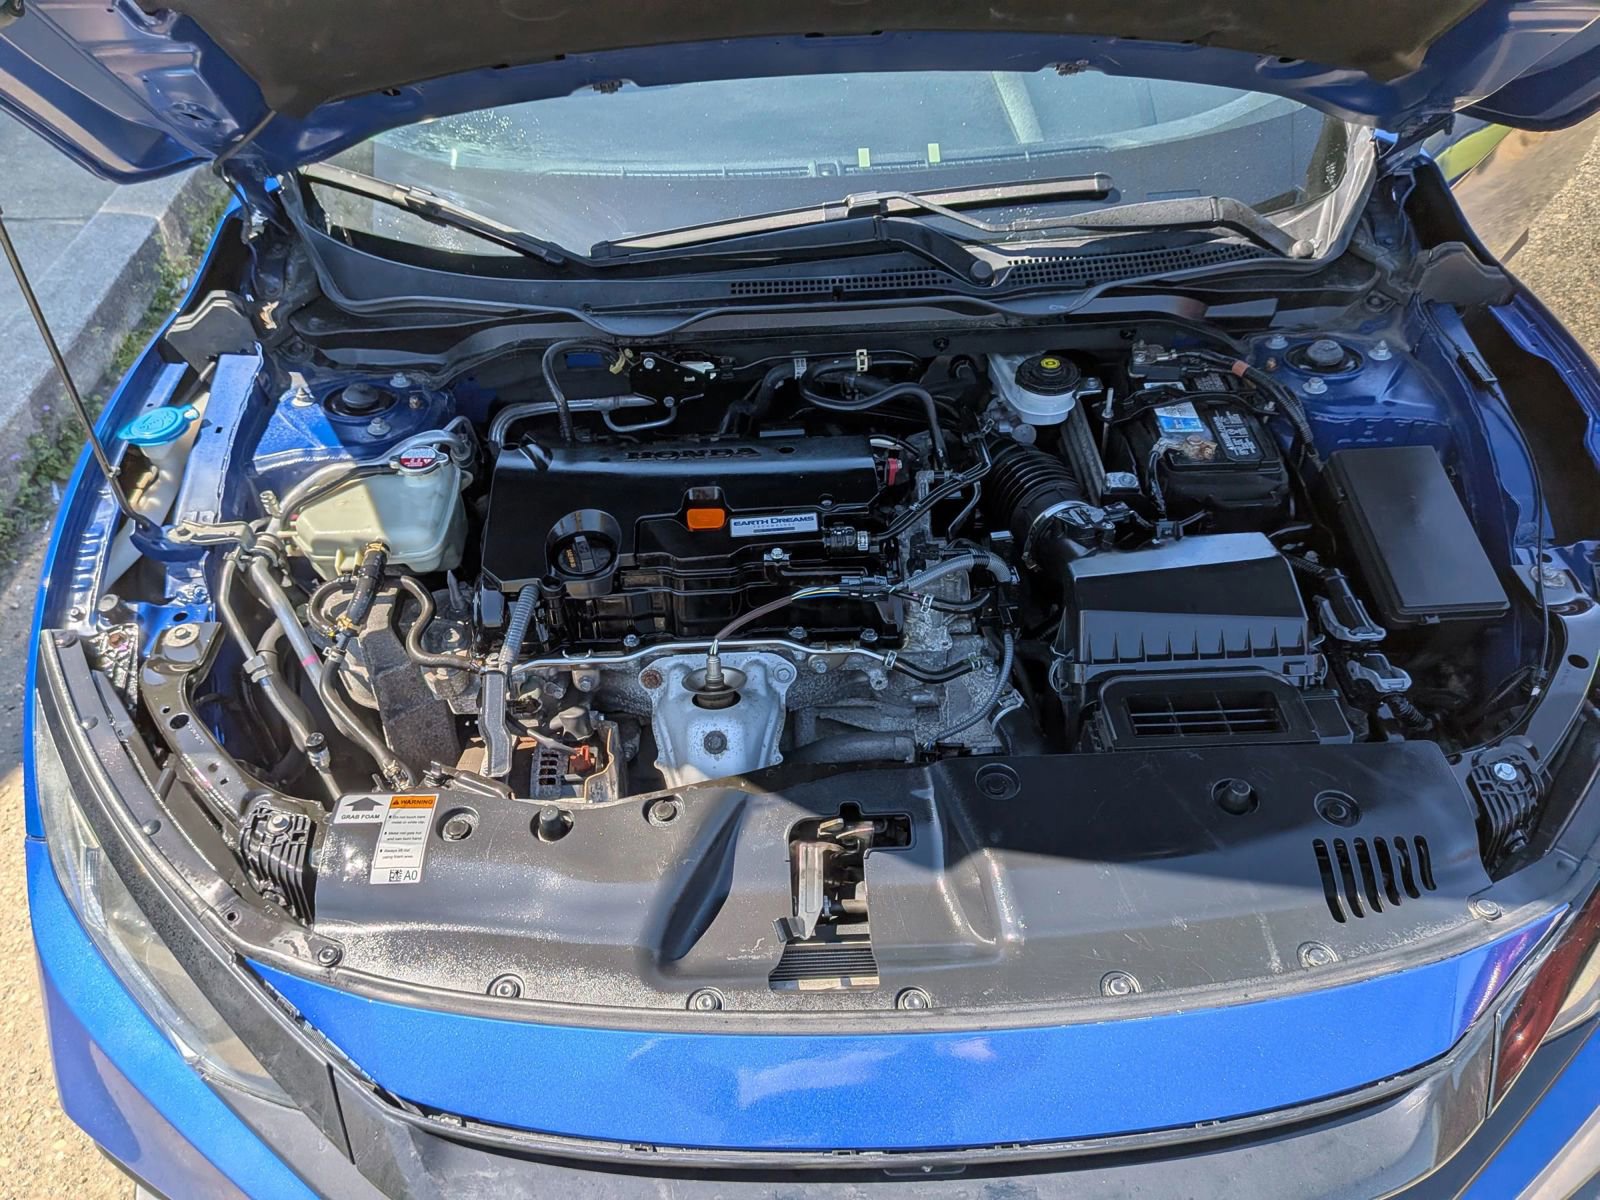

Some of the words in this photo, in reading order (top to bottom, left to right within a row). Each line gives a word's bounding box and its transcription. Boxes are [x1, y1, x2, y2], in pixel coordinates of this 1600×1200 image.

[626, 447, 761, 461] HONDA
[733, 519, 769, 527] EARTH
[770, 515, 815, 524] DREAMS
